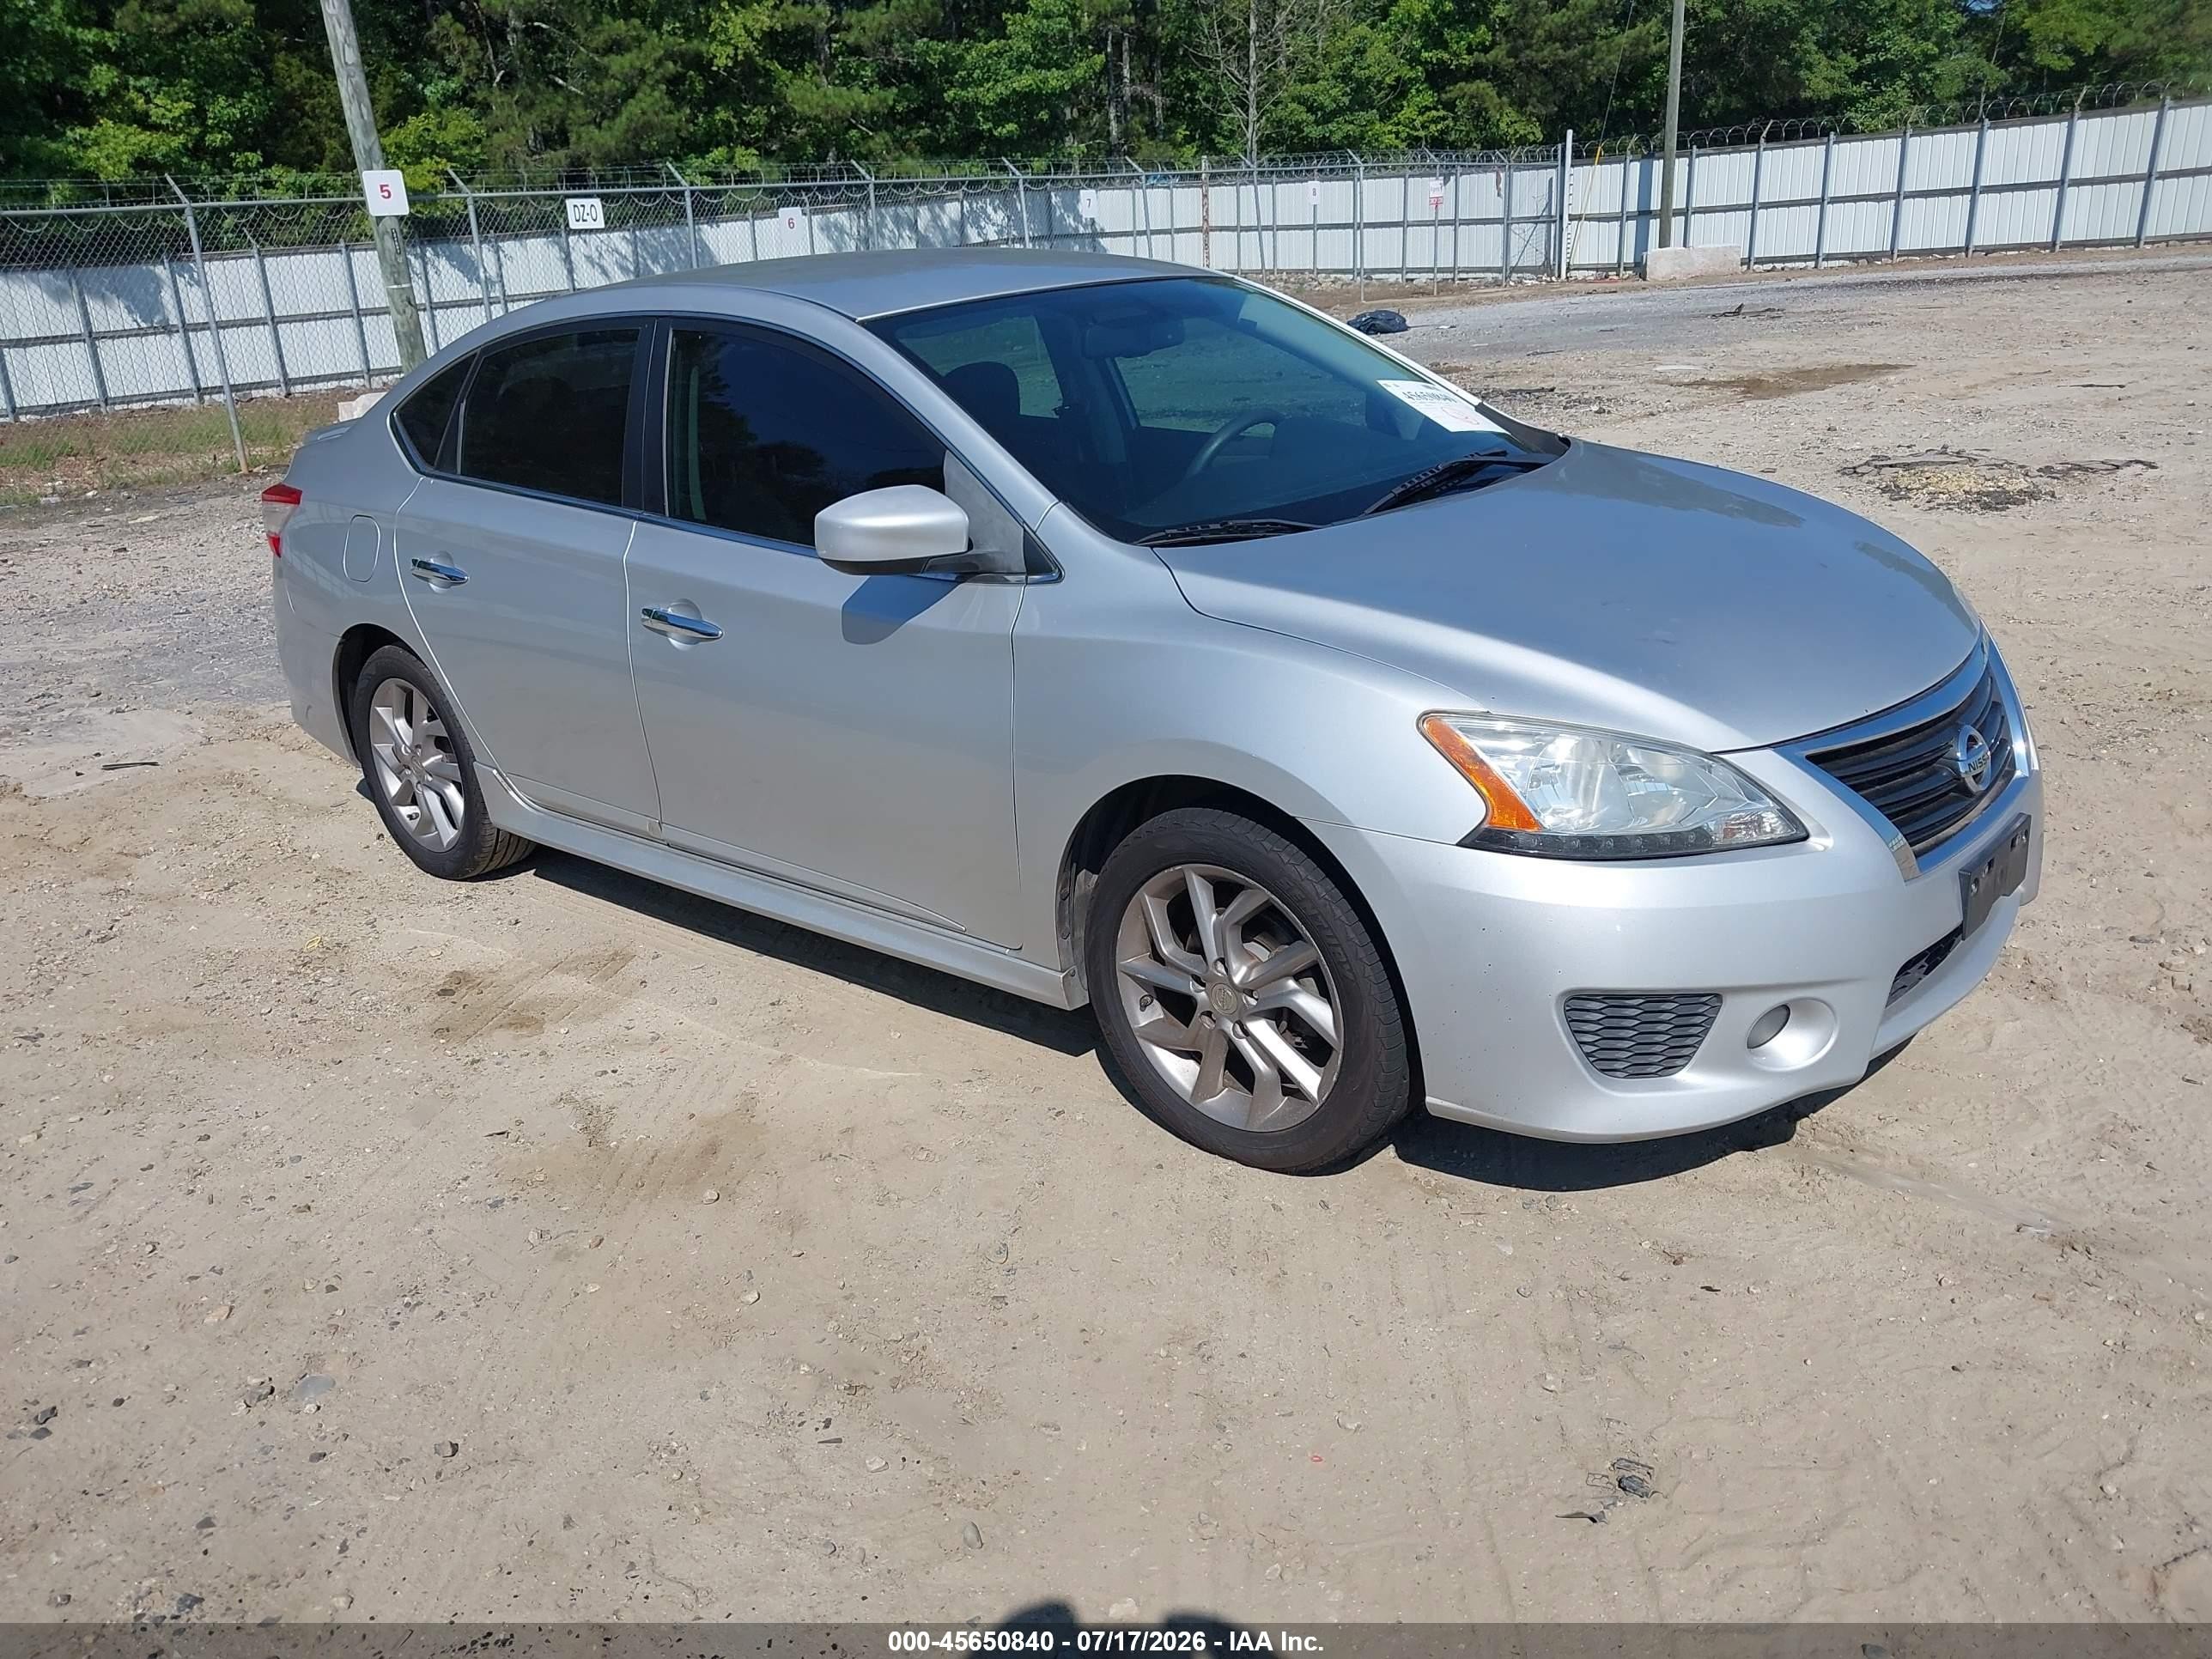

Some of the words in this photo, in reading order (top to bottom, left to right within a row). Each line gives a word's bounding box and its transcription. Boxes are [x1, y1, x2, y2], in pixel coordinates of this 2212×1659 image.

[379, 184, 392, 199] 5
[1312, 187, 1317, 197] 8
[1086, 198, 1091, 208] 7
[787, 217, 795, 229] 6
